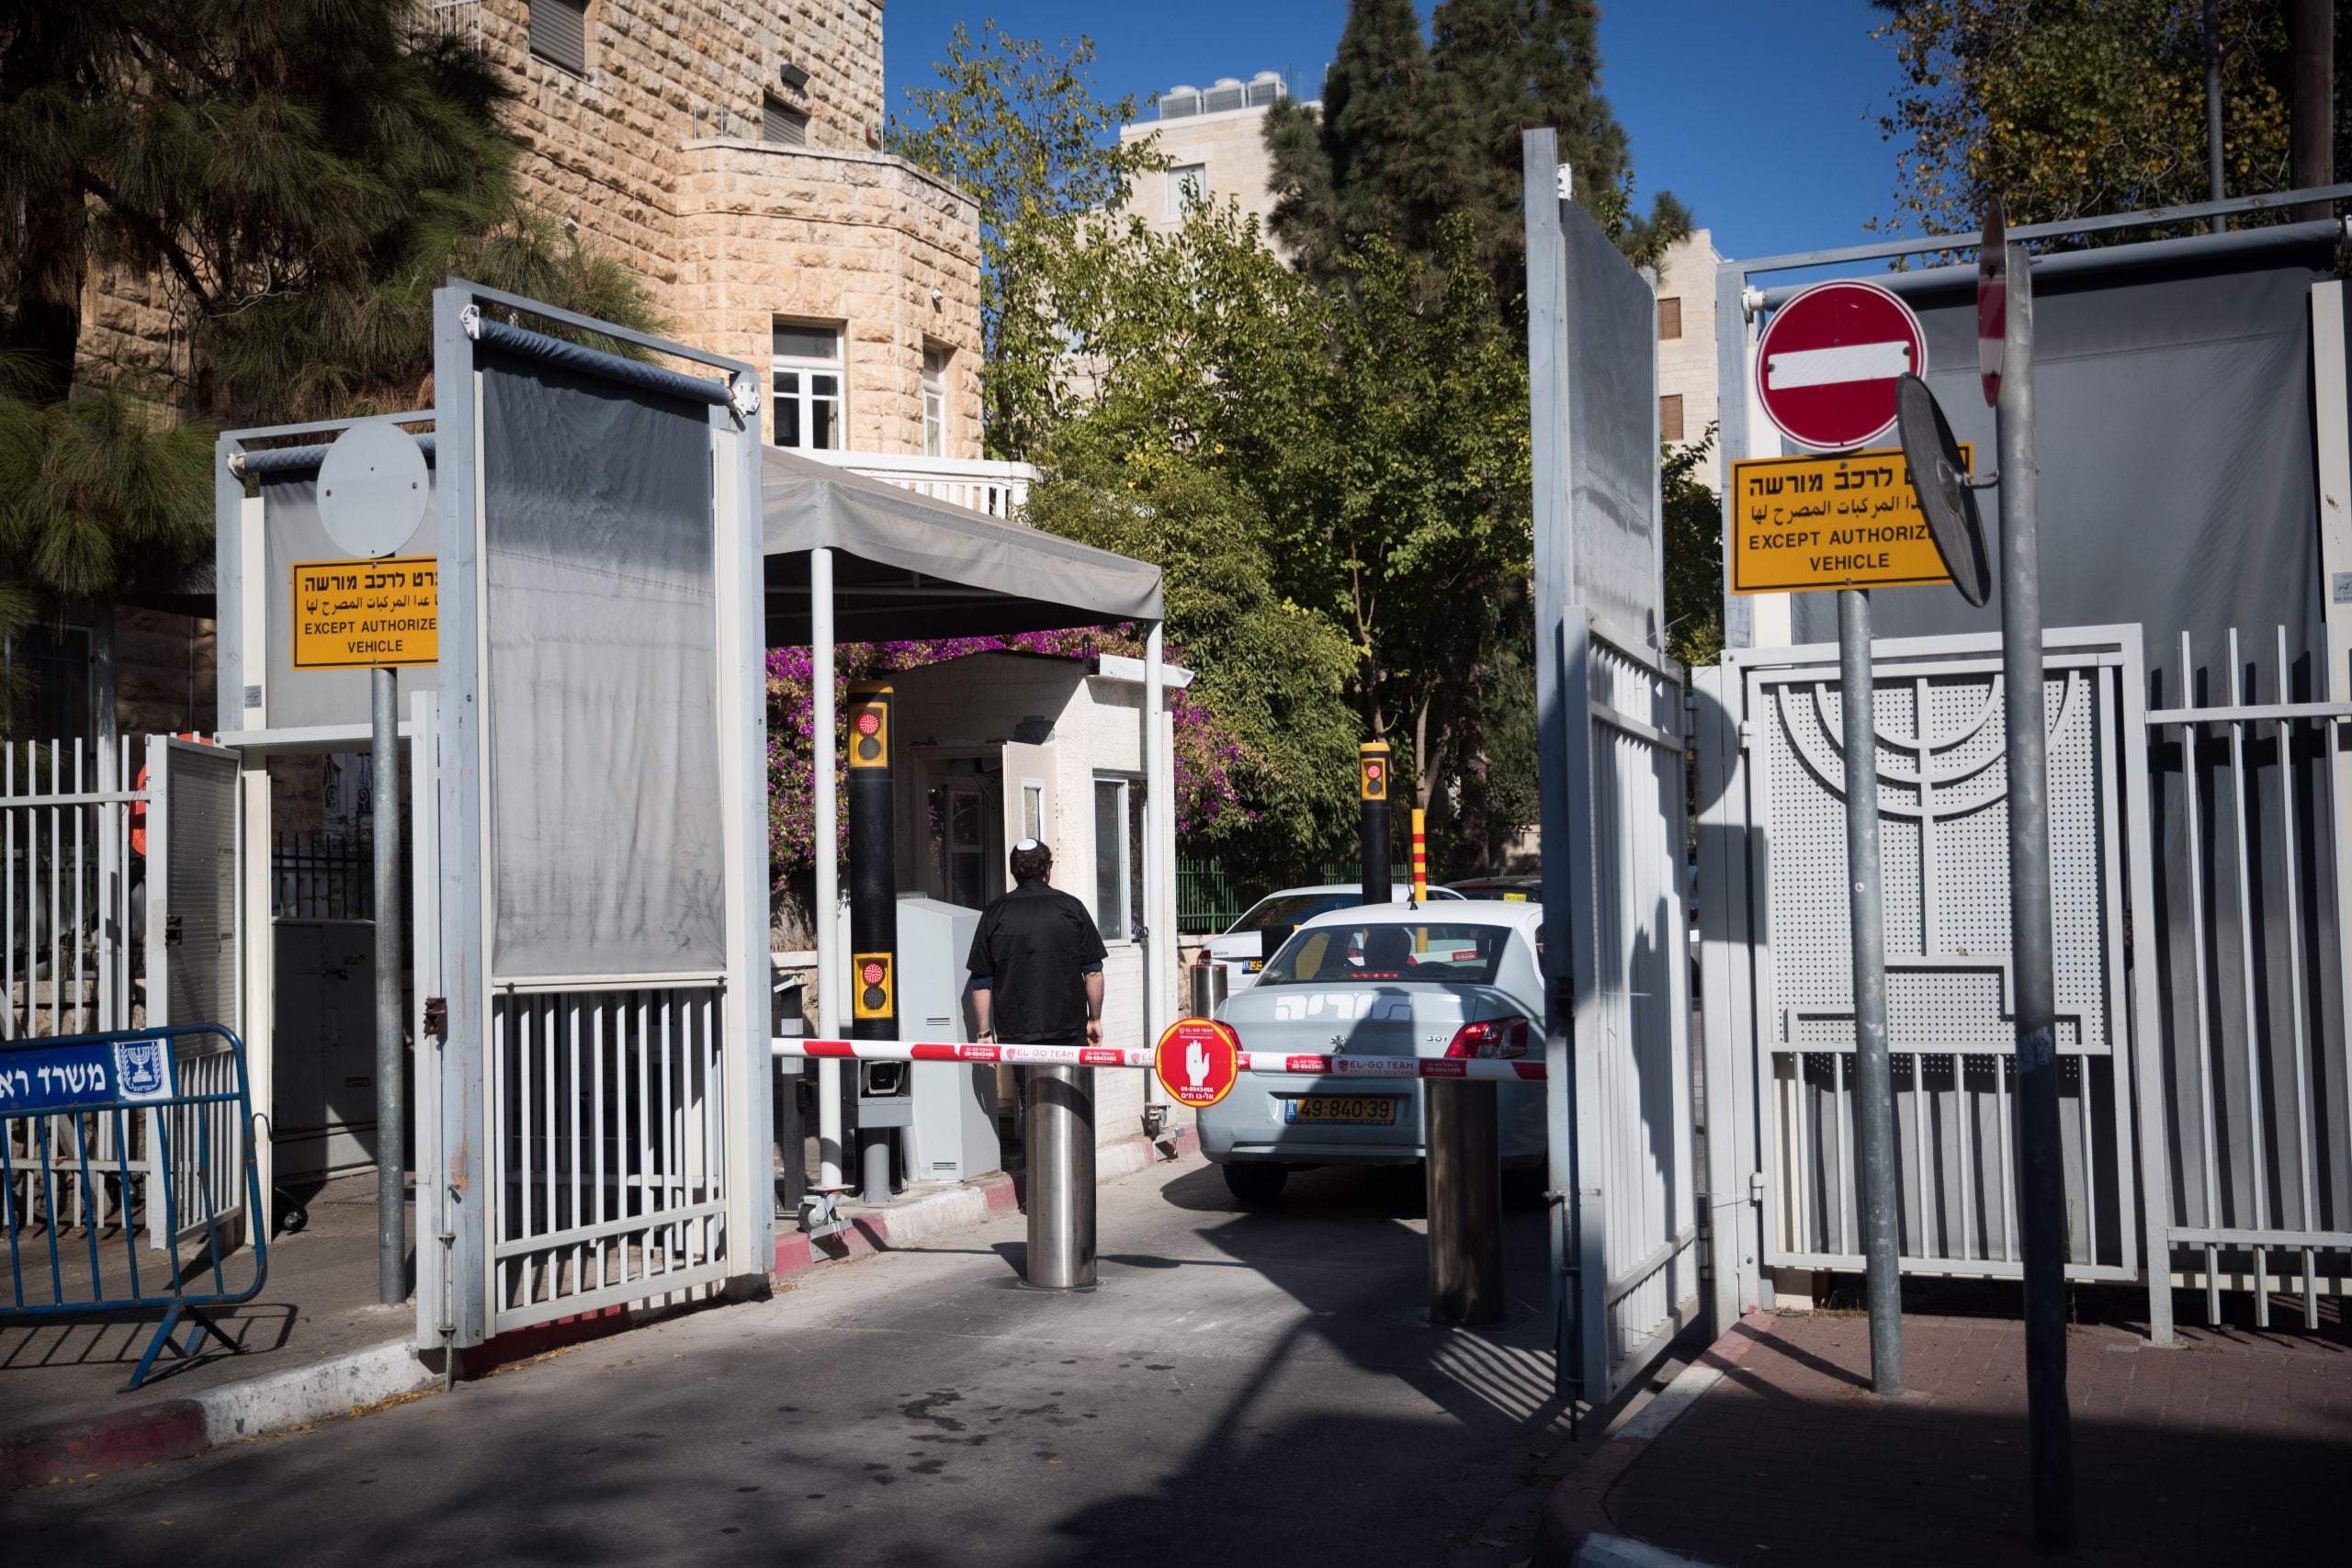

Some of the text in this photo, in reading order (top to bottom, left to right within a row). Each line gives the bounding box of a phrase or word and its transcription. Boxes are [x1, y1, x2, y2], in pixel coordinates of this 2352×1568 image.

[1749, 474, 1823, 497] מורשה
[1834, 467, 1893, 491] לרכב
[1751, 504, 1768, 525] لها
[1774, 501, 1831, 526] المصرح
[1837, 496, 1899, 518] المركبات
[1749, 525, 1932, 550] EXCEPT AUTHORIZ
[1810, 553, 1890, 571] VEHICLE
[305, 571, 438, 592] רט לרכב מורשה
[306, 599, 318, 615] لها
[322, 597, 363, 616] المصرح
[367, 595, 410, 613] المركبات
[305, 618, 437, 635] EXCEPT AUTHORIZE
[347, 640, 403, 653] VEHICLE
[1017, 1049, 1047, 1057] EL-GO
[1350, 1060, 1414, 1069] EL-GO TEAM
[0, 1062, 106, 1099] משרד רא
